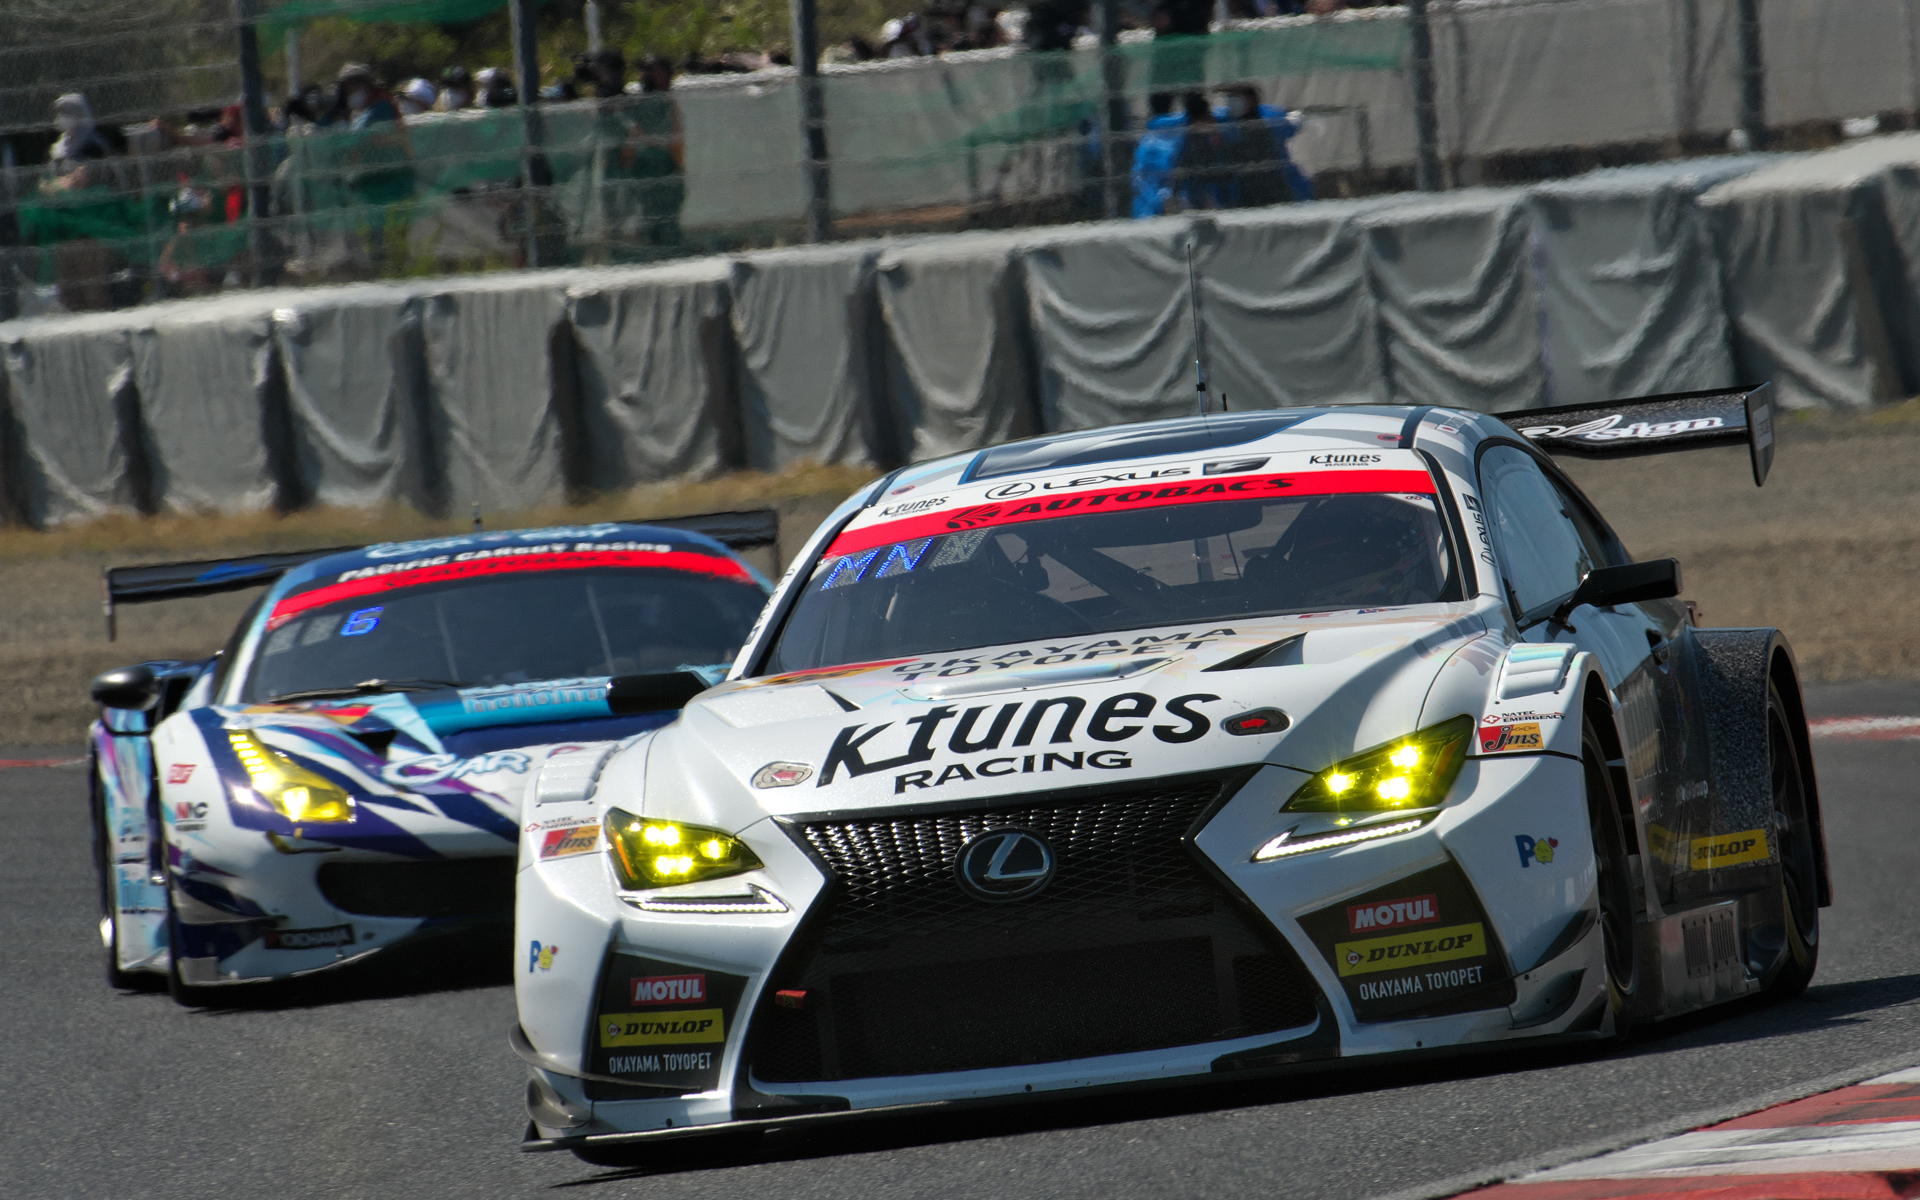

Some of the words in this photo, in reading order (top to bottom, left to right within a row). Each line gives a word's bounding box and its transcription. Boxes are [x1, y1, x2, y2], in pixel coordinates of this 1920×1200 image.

[1044, 467, 1191, 489] LEXUS
[1003, 478, 1296, 518] AUTOBACS
[336, 554, 450, 584] PACIFIC
[573, 541, 673, 554] Racing
[340, 606, 384, 637] 6
[896, 638, 1219, 682] TOYOPET
[901, 628, 1238, 674] OKAYAMA
[1503, 714, 1566, 722] EMERGENCY
[894, 750, 1134, 795] RACING
[1354, 899, 1435, 930] MOTUL
[1366, 933, 1473, 963] DUNLOP
[634, 979, 703, 1001] MOTUL
[1359, 976, 1423, 1001] OKAYAMA
[1426, 965, 1483, 990] TOYOPET
[623, 1019, 713, 1036] DUNLOP
[609, 1055, 660, 1075] OKAYAMA
[663, 1052, 712, 1071] TOYOPET
